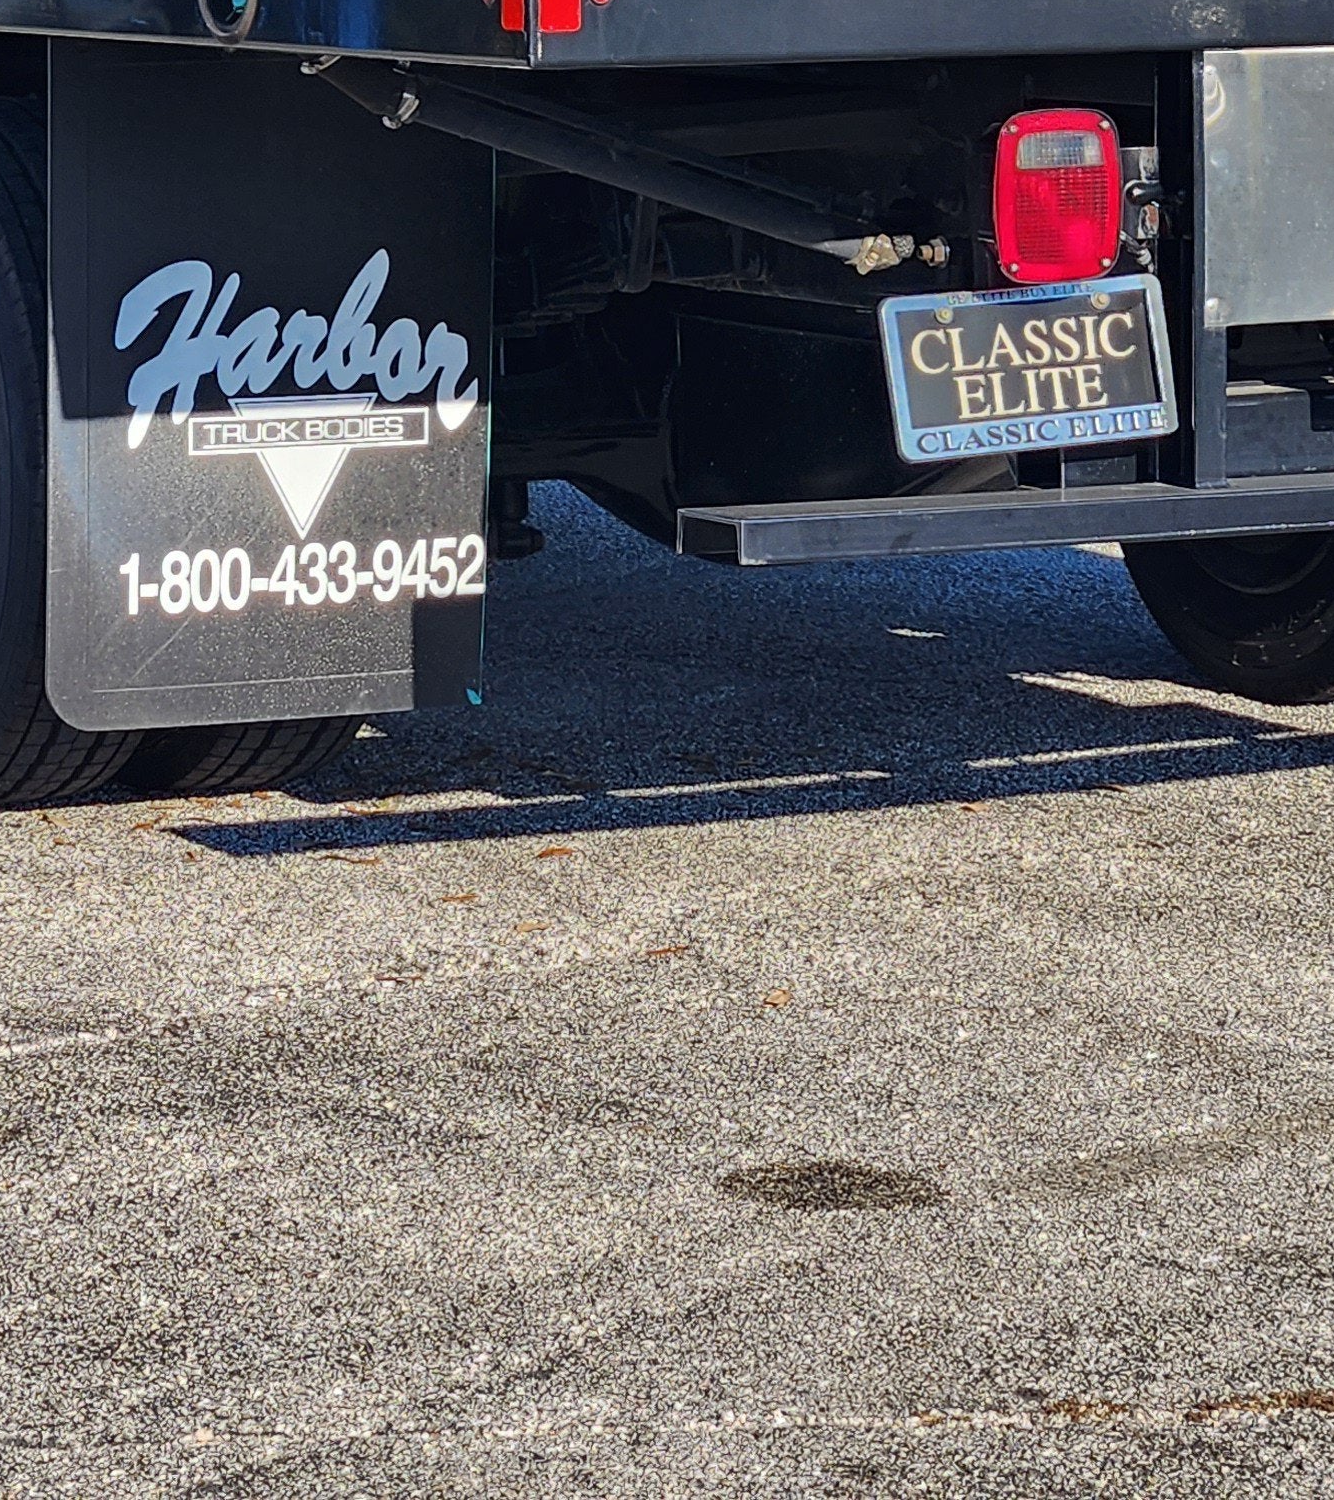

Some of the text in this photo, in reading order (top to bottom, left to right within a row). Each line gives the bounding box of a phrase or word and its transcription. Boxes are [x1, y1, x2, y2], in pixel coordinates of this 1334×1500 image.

[1019, 286, 1048, 299] BUY
[1053, 283, 1095, 296] ELITE
[114, 247, 478, 450] Harbor
[911, 312, 1137, 374] CLASSIC
[954, 363, 1109, 420] ELITE
[203, 416, 405, 445] TRUCK BODIES
[917, 408, 1166, 455] CLASSIC ELITE
[119, 534, 486, 616] 1-800-433-9452
